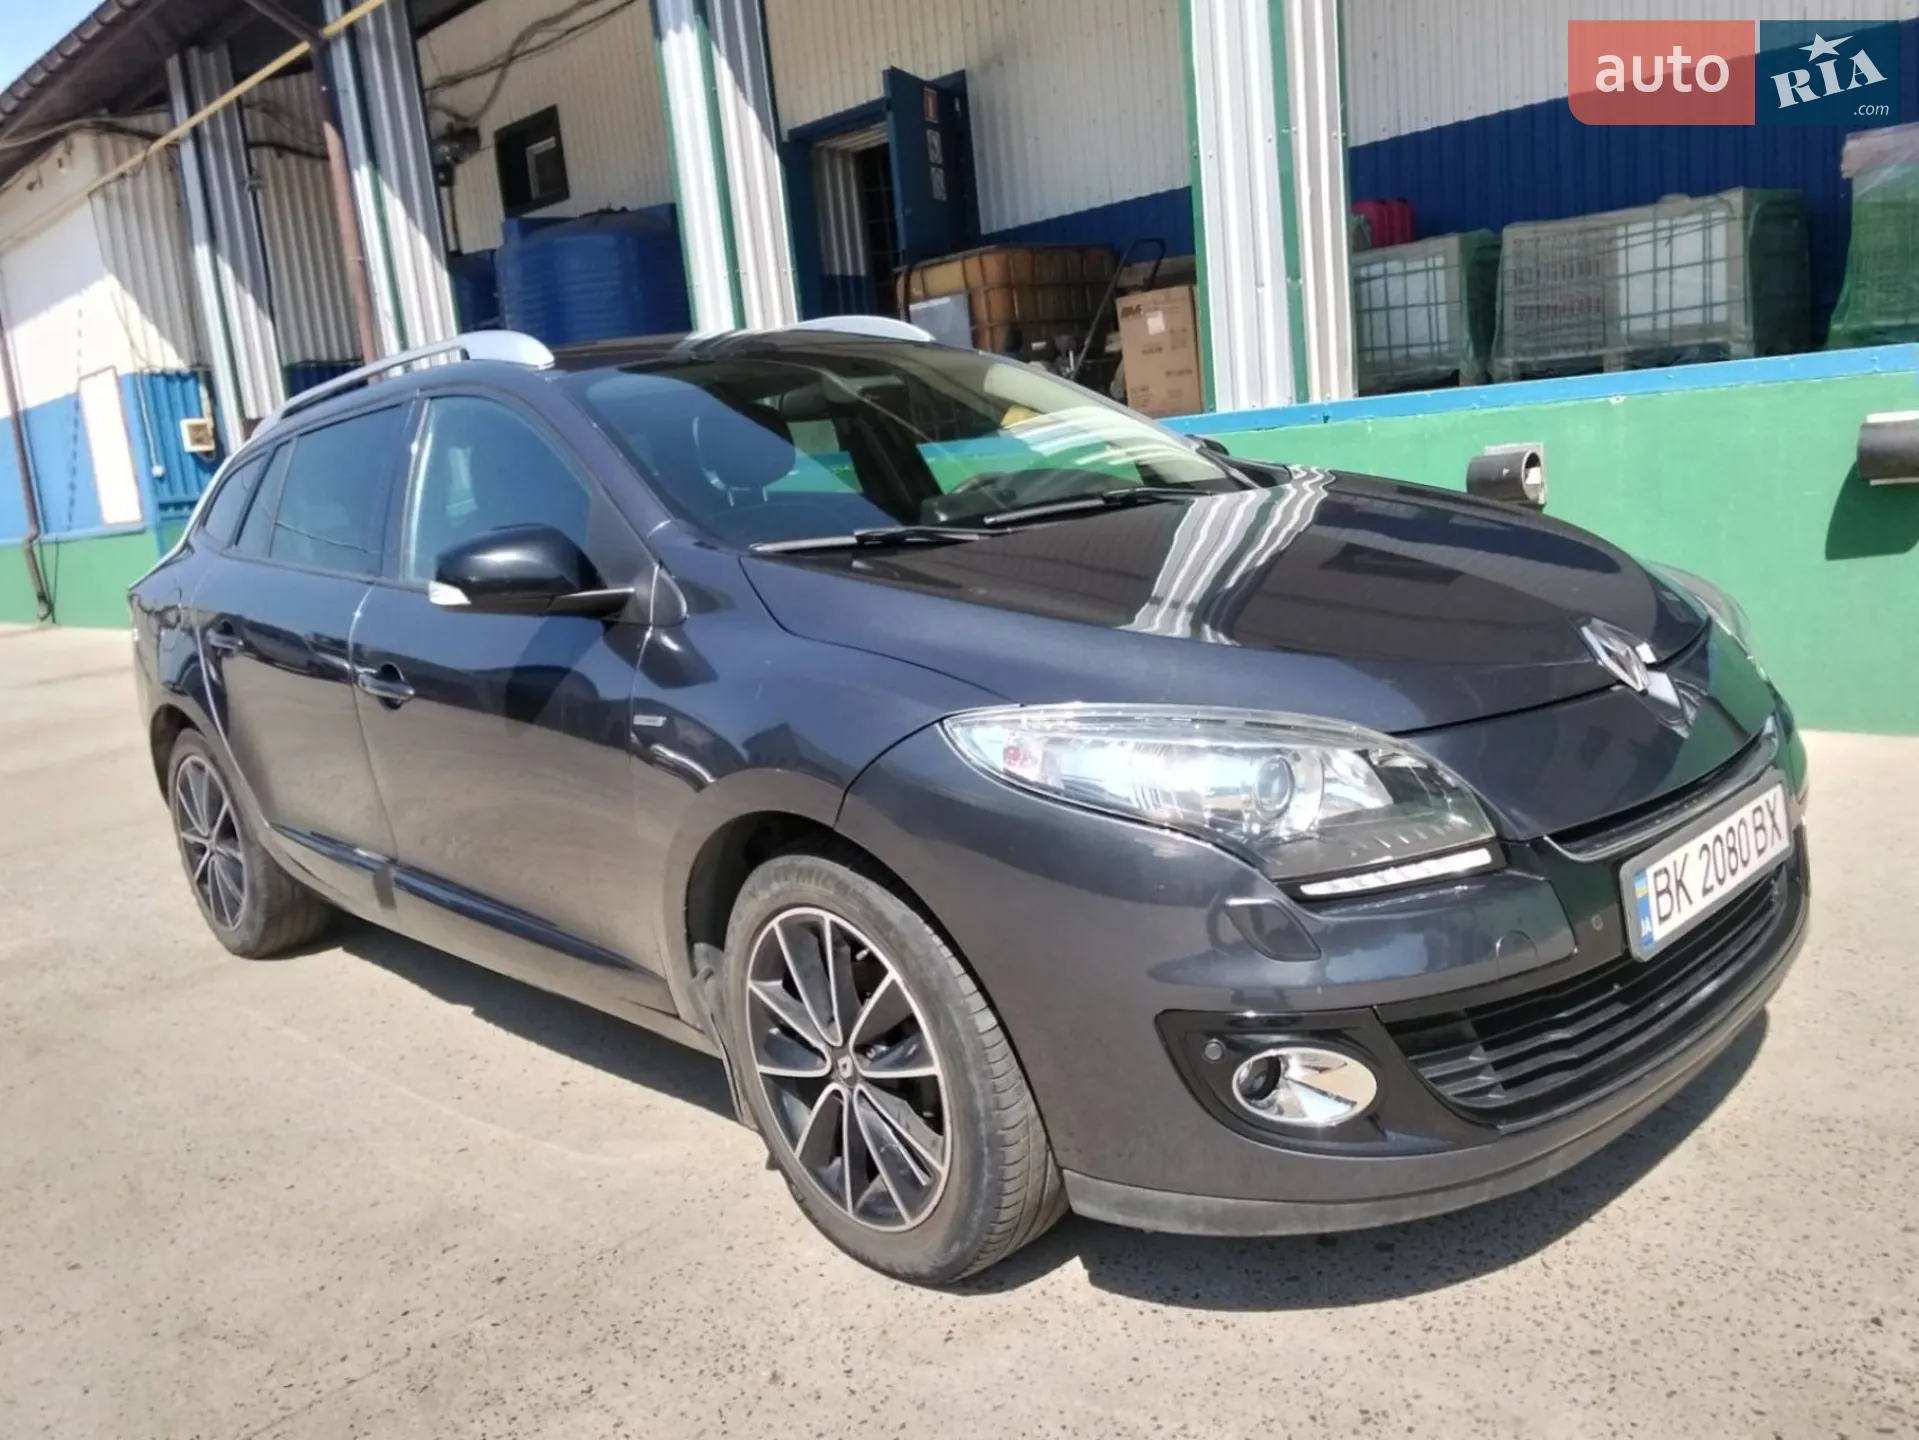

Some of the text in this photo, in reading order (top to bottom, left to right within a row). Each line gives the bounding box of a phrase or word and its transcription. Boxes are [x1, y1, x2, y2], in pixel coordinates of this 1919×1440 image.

[1653, 793, 1782, 925] BK 2080 BX
